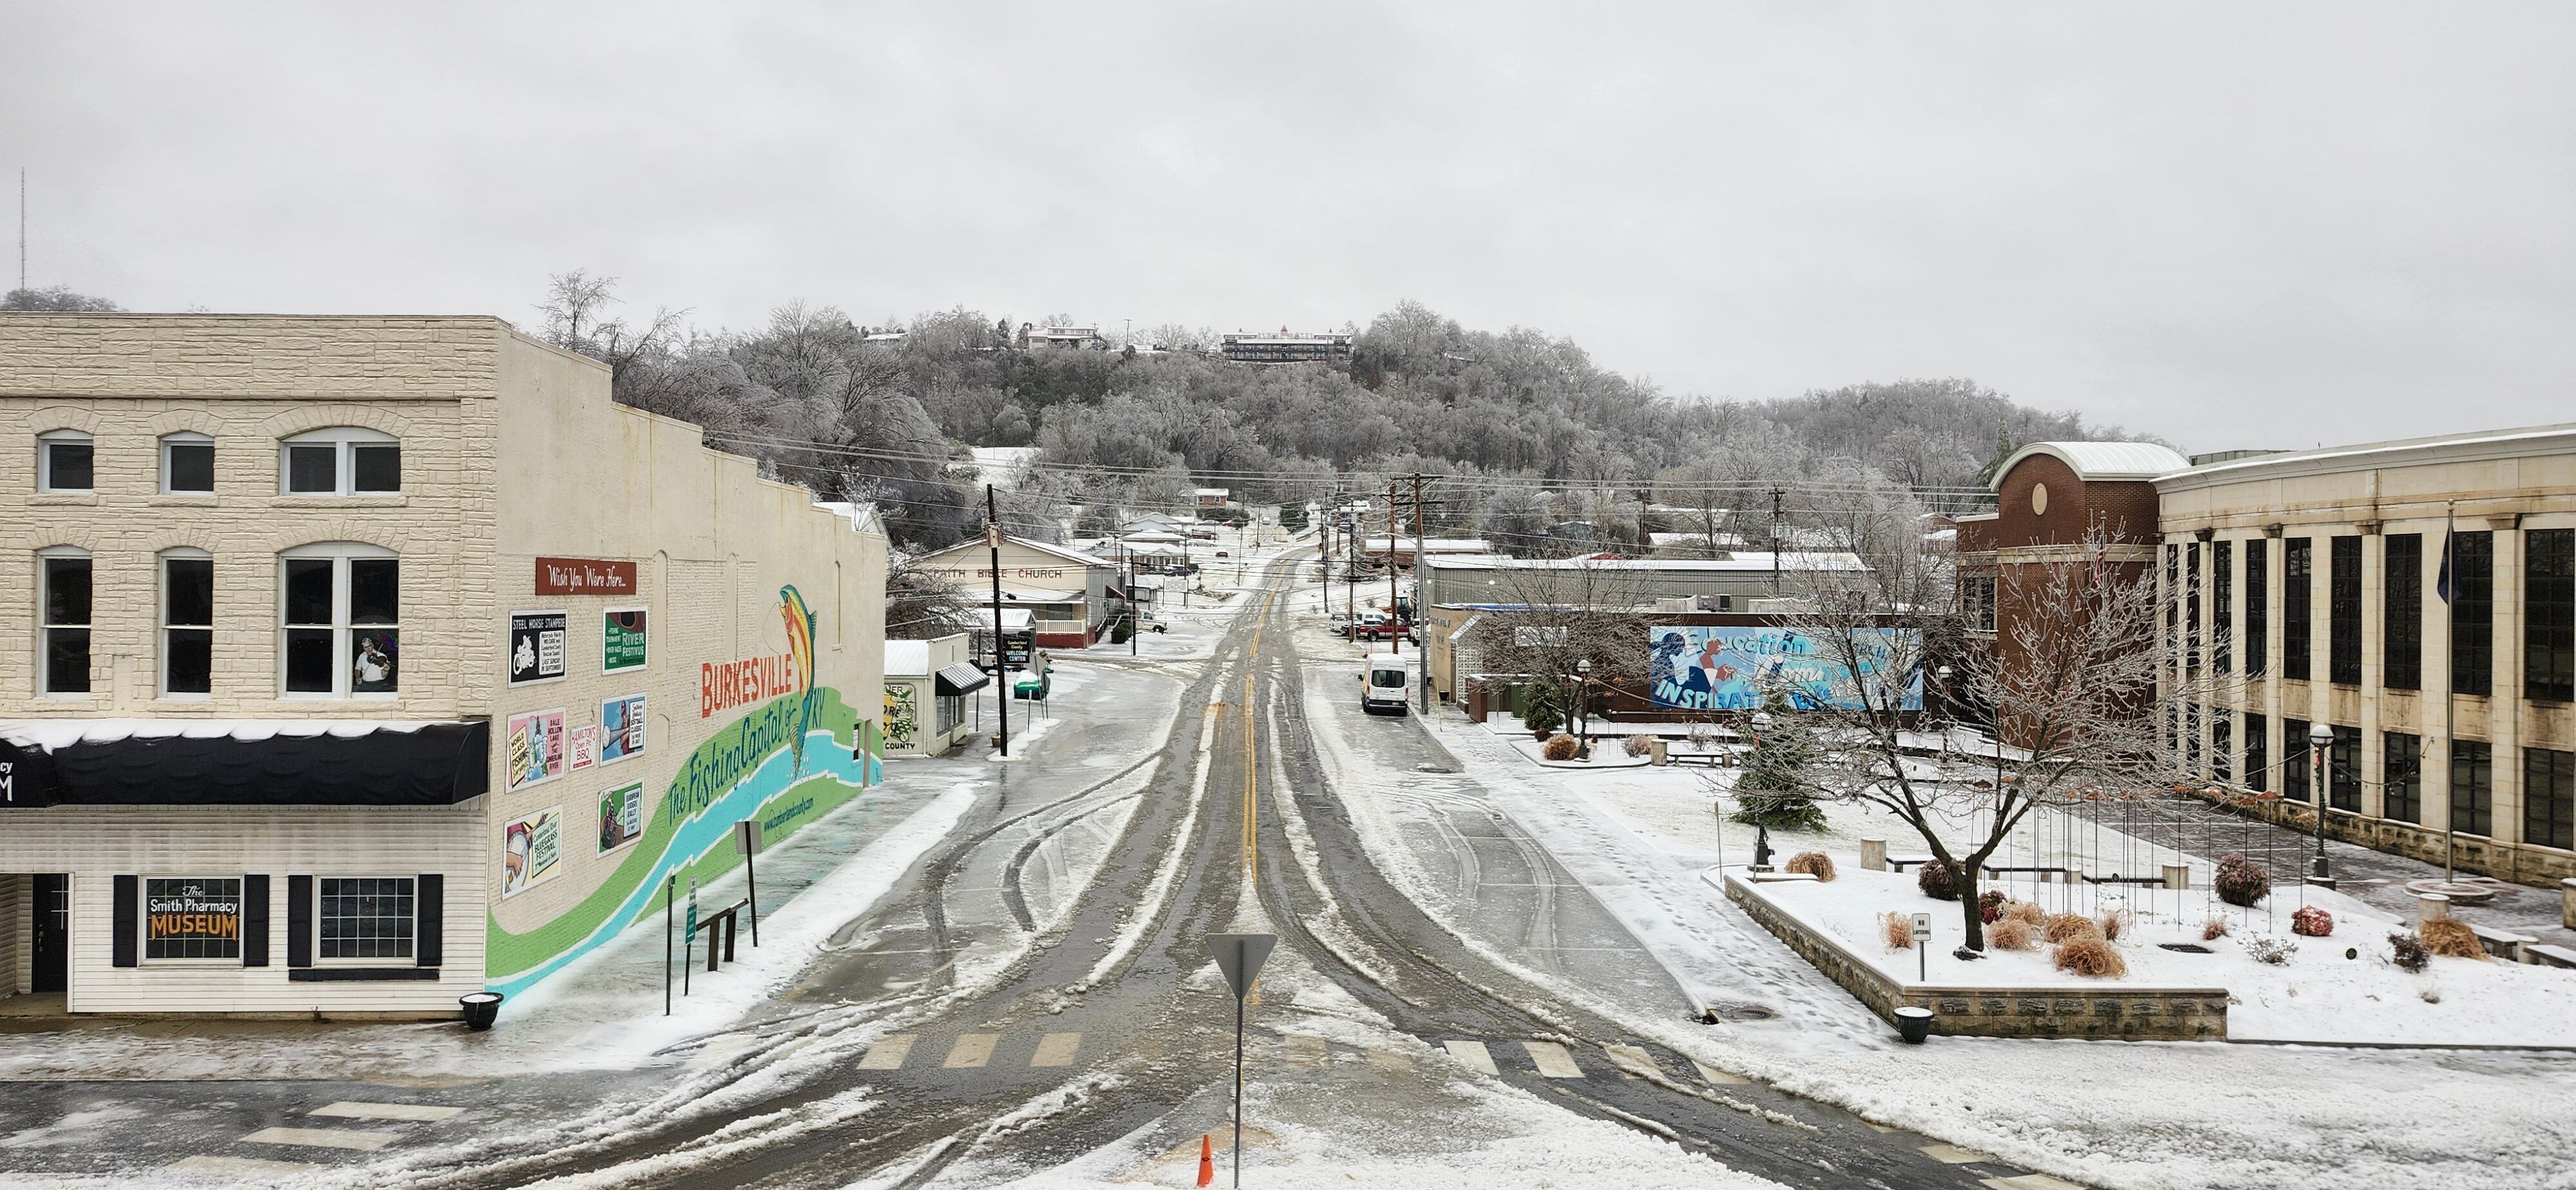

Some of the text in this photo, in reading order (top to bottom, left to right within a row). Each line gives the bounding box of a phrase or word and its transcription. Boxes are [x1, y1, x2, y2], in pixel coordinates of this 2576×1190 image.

[547, 564, 567, 587] Wish
[569, 567, 582, 592] You
[584, 565, 604, 587] Were
[934, 569, 1062, 578] FAITH BIBE CHURCH
[513, 618, 565, 630] STEEL HORSE STAMPEDE
[622, 632, 645, 647] RIVER
[702, 654, 791, 719] BURKESVILLE
[1654, 679, 1774, 709] INSPIRAT
[548, 726, 563, 735] HOLLOW
[511, 733, 524, 748] WORLD
[576, 741, 585, 750] Open
[512, 741, 526, 757] CLASS
[577, 748, 589, 760] BBQ
[668, 687, 825, 827] The Fishing Capital of KY
[0, 762, 13, 773] cy
[534, 829, 558, 853] BLUEGRASS
[536, 840, 556, 860] FESTIVAL
[182, 885, 204, 896] The
[150, 898, 238, 914] Smith Pharmacy
[151, 914, 237, 941] MUSEUM
